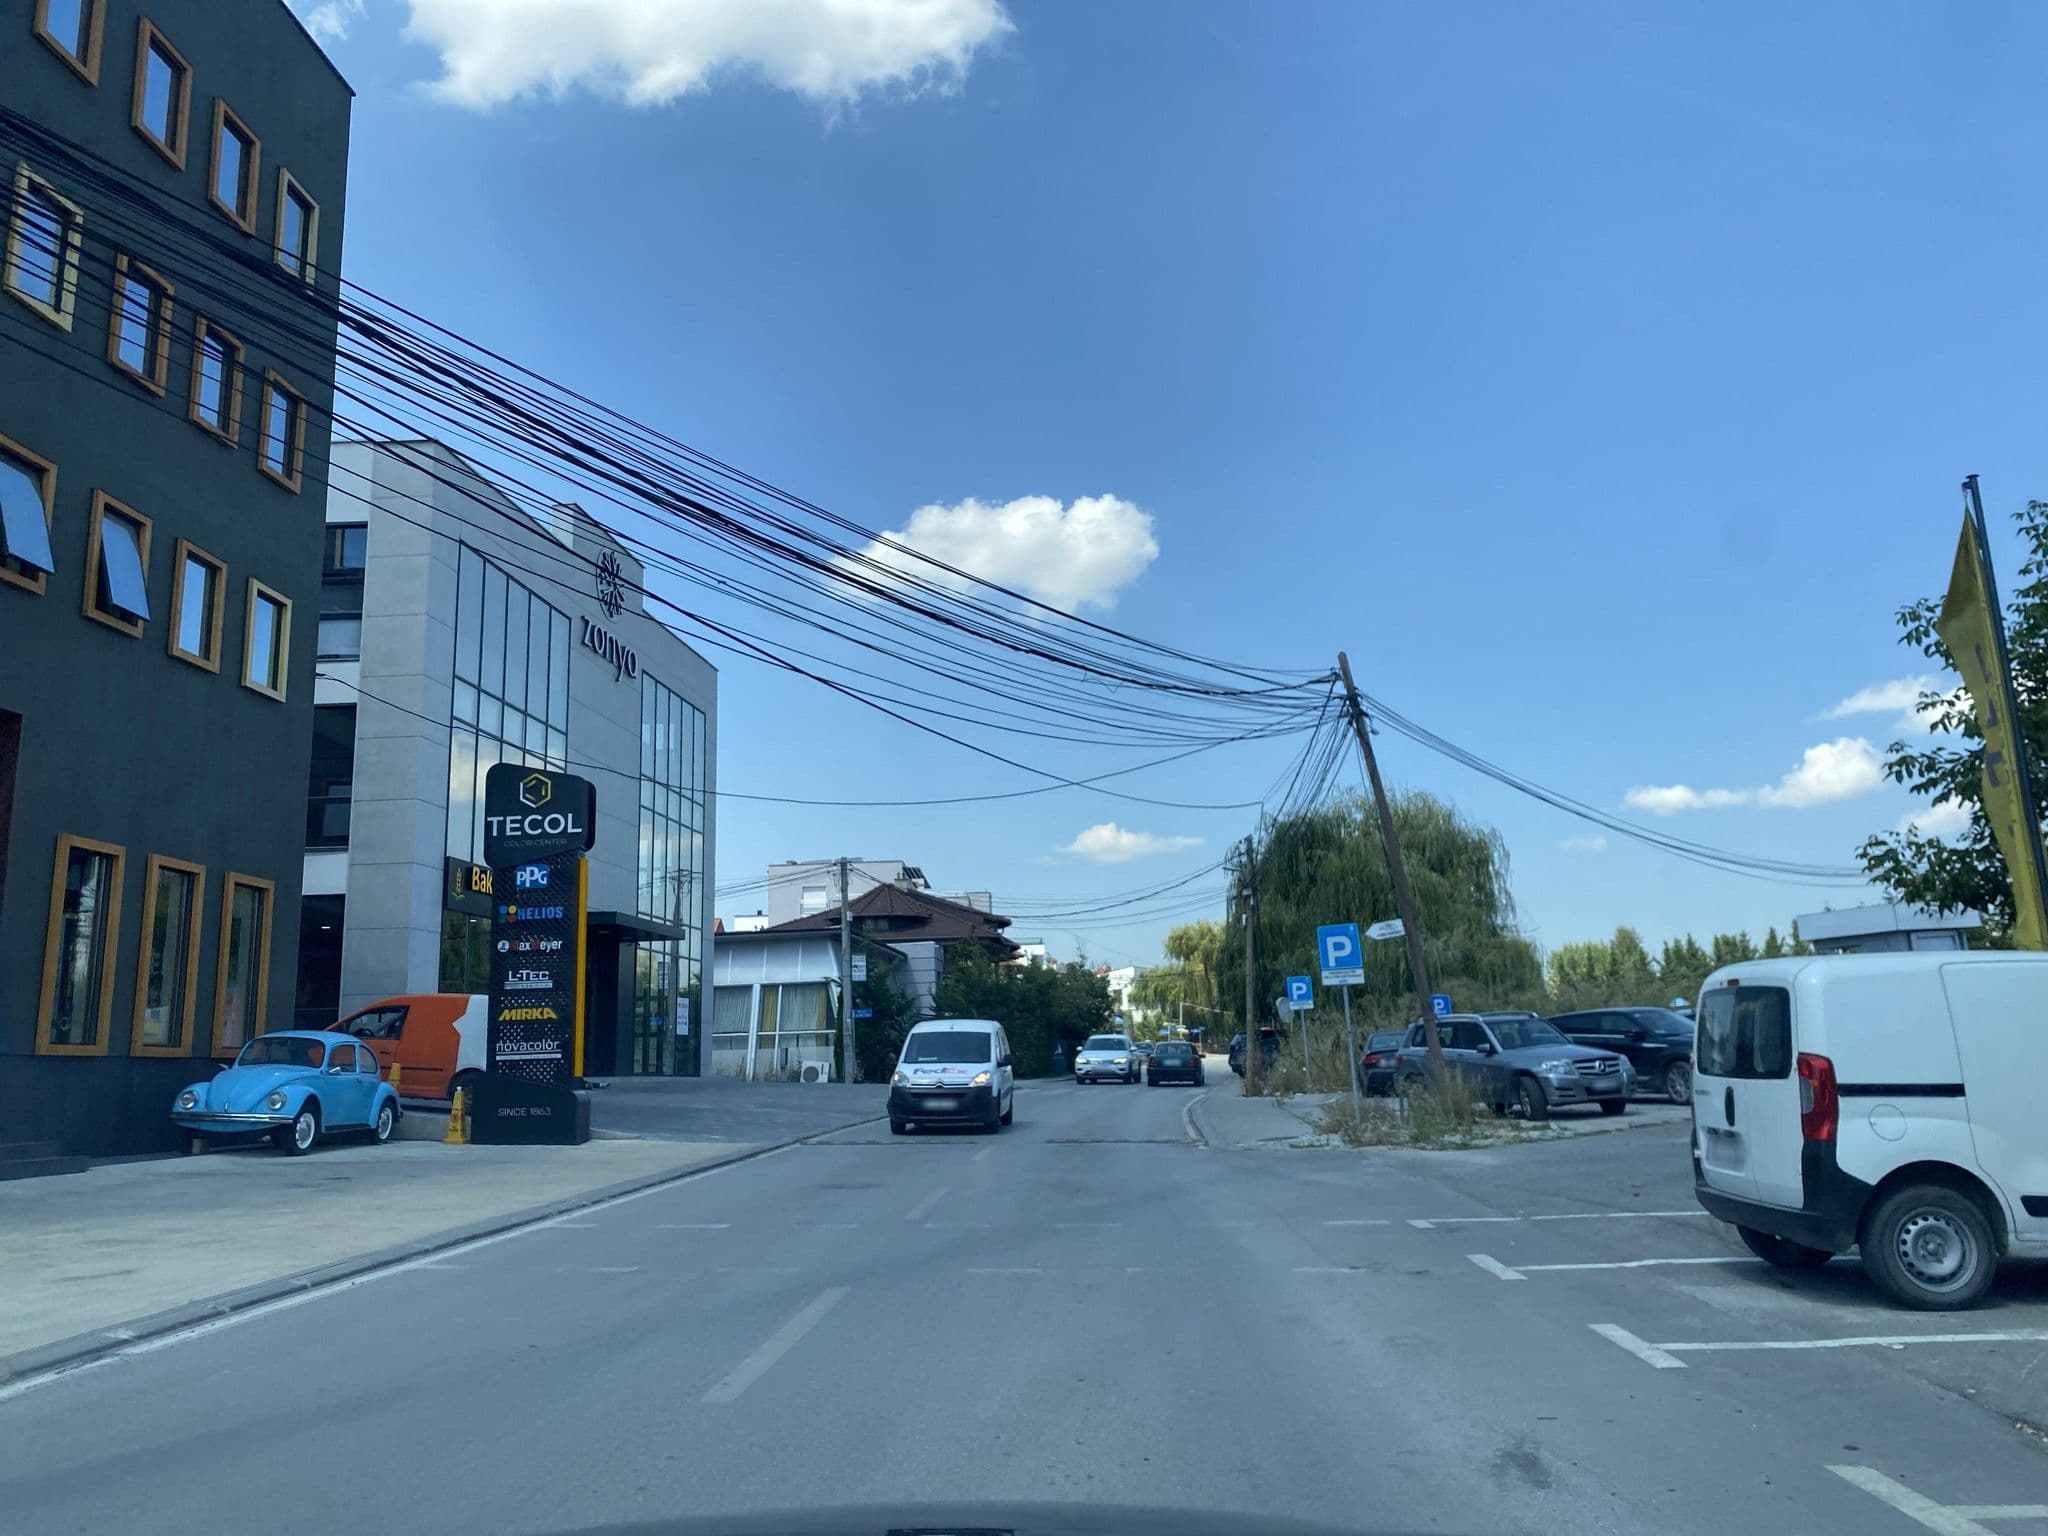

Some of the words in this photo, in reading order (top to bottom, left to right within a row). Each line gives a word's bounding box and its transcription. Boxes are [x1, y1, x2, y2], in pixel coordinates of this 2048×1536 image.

[581, 615, 638, 682] zonyo
[487, 813, 583, 837] TECOL
[534, 837, 567, 847] CENTER
[471, 866, 493, 895] Bak
[516, 866, 548, 888] PPG
[517, 905, 565, 920] HELIOS
[1326, 935, 1352, 967] P
[508, 970, 550, 981] L-TEC
[1293, 983, 1307, 1001] P
[498, 1007, 558, 1021] MIRKA
[1433, 999, 1445, 1015] P
[496, 1038, 560, 1052] novacolor
[498, 1107, 527, 1117] SINCE
